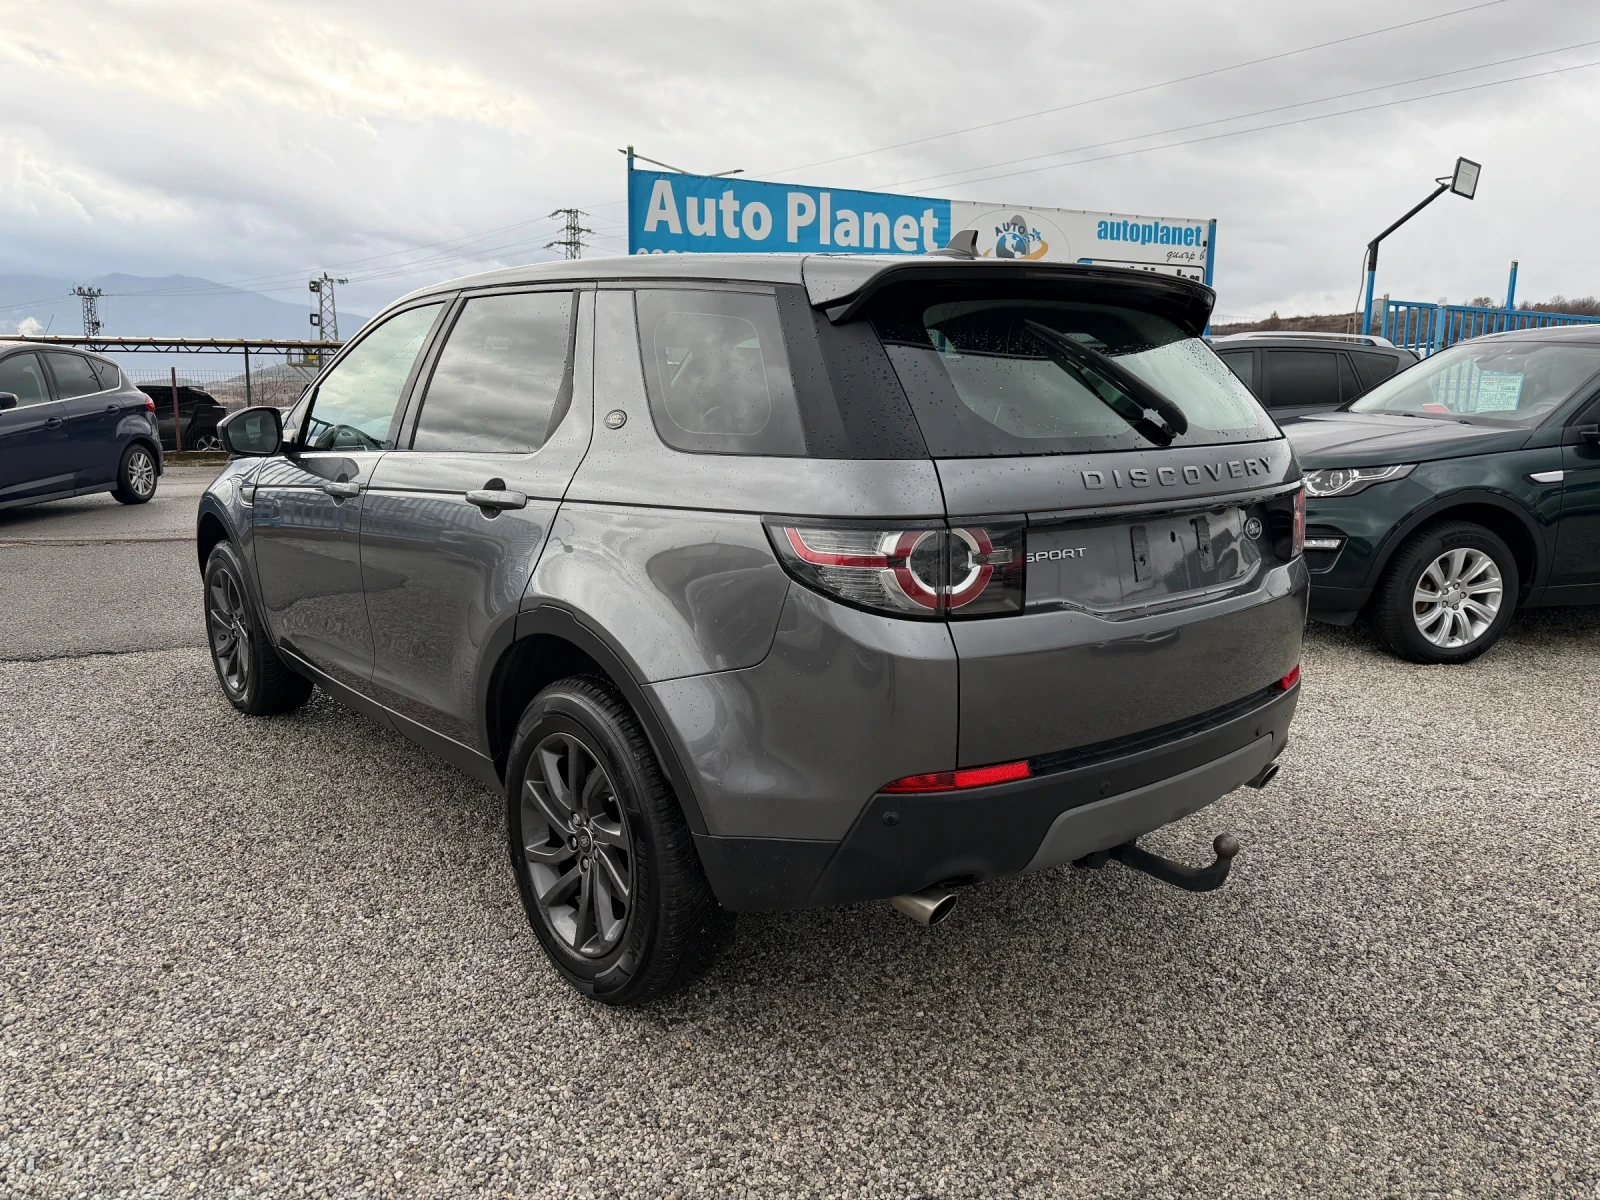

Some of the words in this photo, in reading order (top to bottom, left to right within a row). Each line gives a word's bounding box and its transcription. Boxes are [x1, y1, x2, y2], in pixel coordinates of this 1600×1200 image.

[643, 179, 773, 241] Auto
[786, 191, 939, 252] Planet
[995, 222, 1026, 237] AUTO
[1080, 457, 1272, 490] DISCOVERY
[1026, 547, 1087, 563] SPORT
